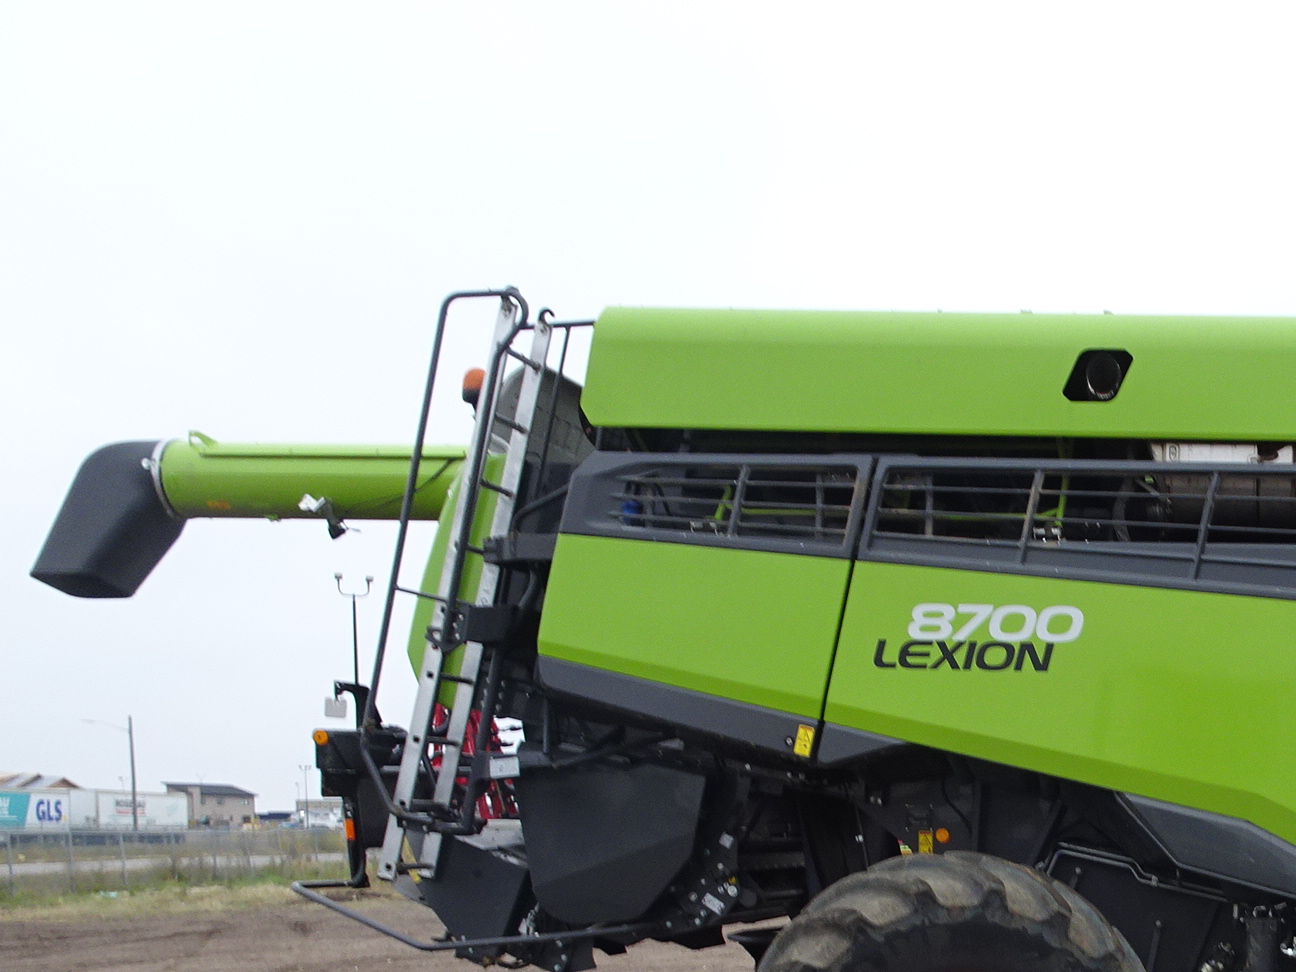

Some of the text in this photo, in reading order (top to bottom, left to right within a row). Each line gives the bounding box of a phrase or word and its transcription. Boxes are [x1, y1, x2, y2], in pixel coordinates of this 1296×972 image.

[907, 602, 1085, 643] 8700
[873, 638, 1054, 672] LEXION
[36, 799, 63, 822] GLS
